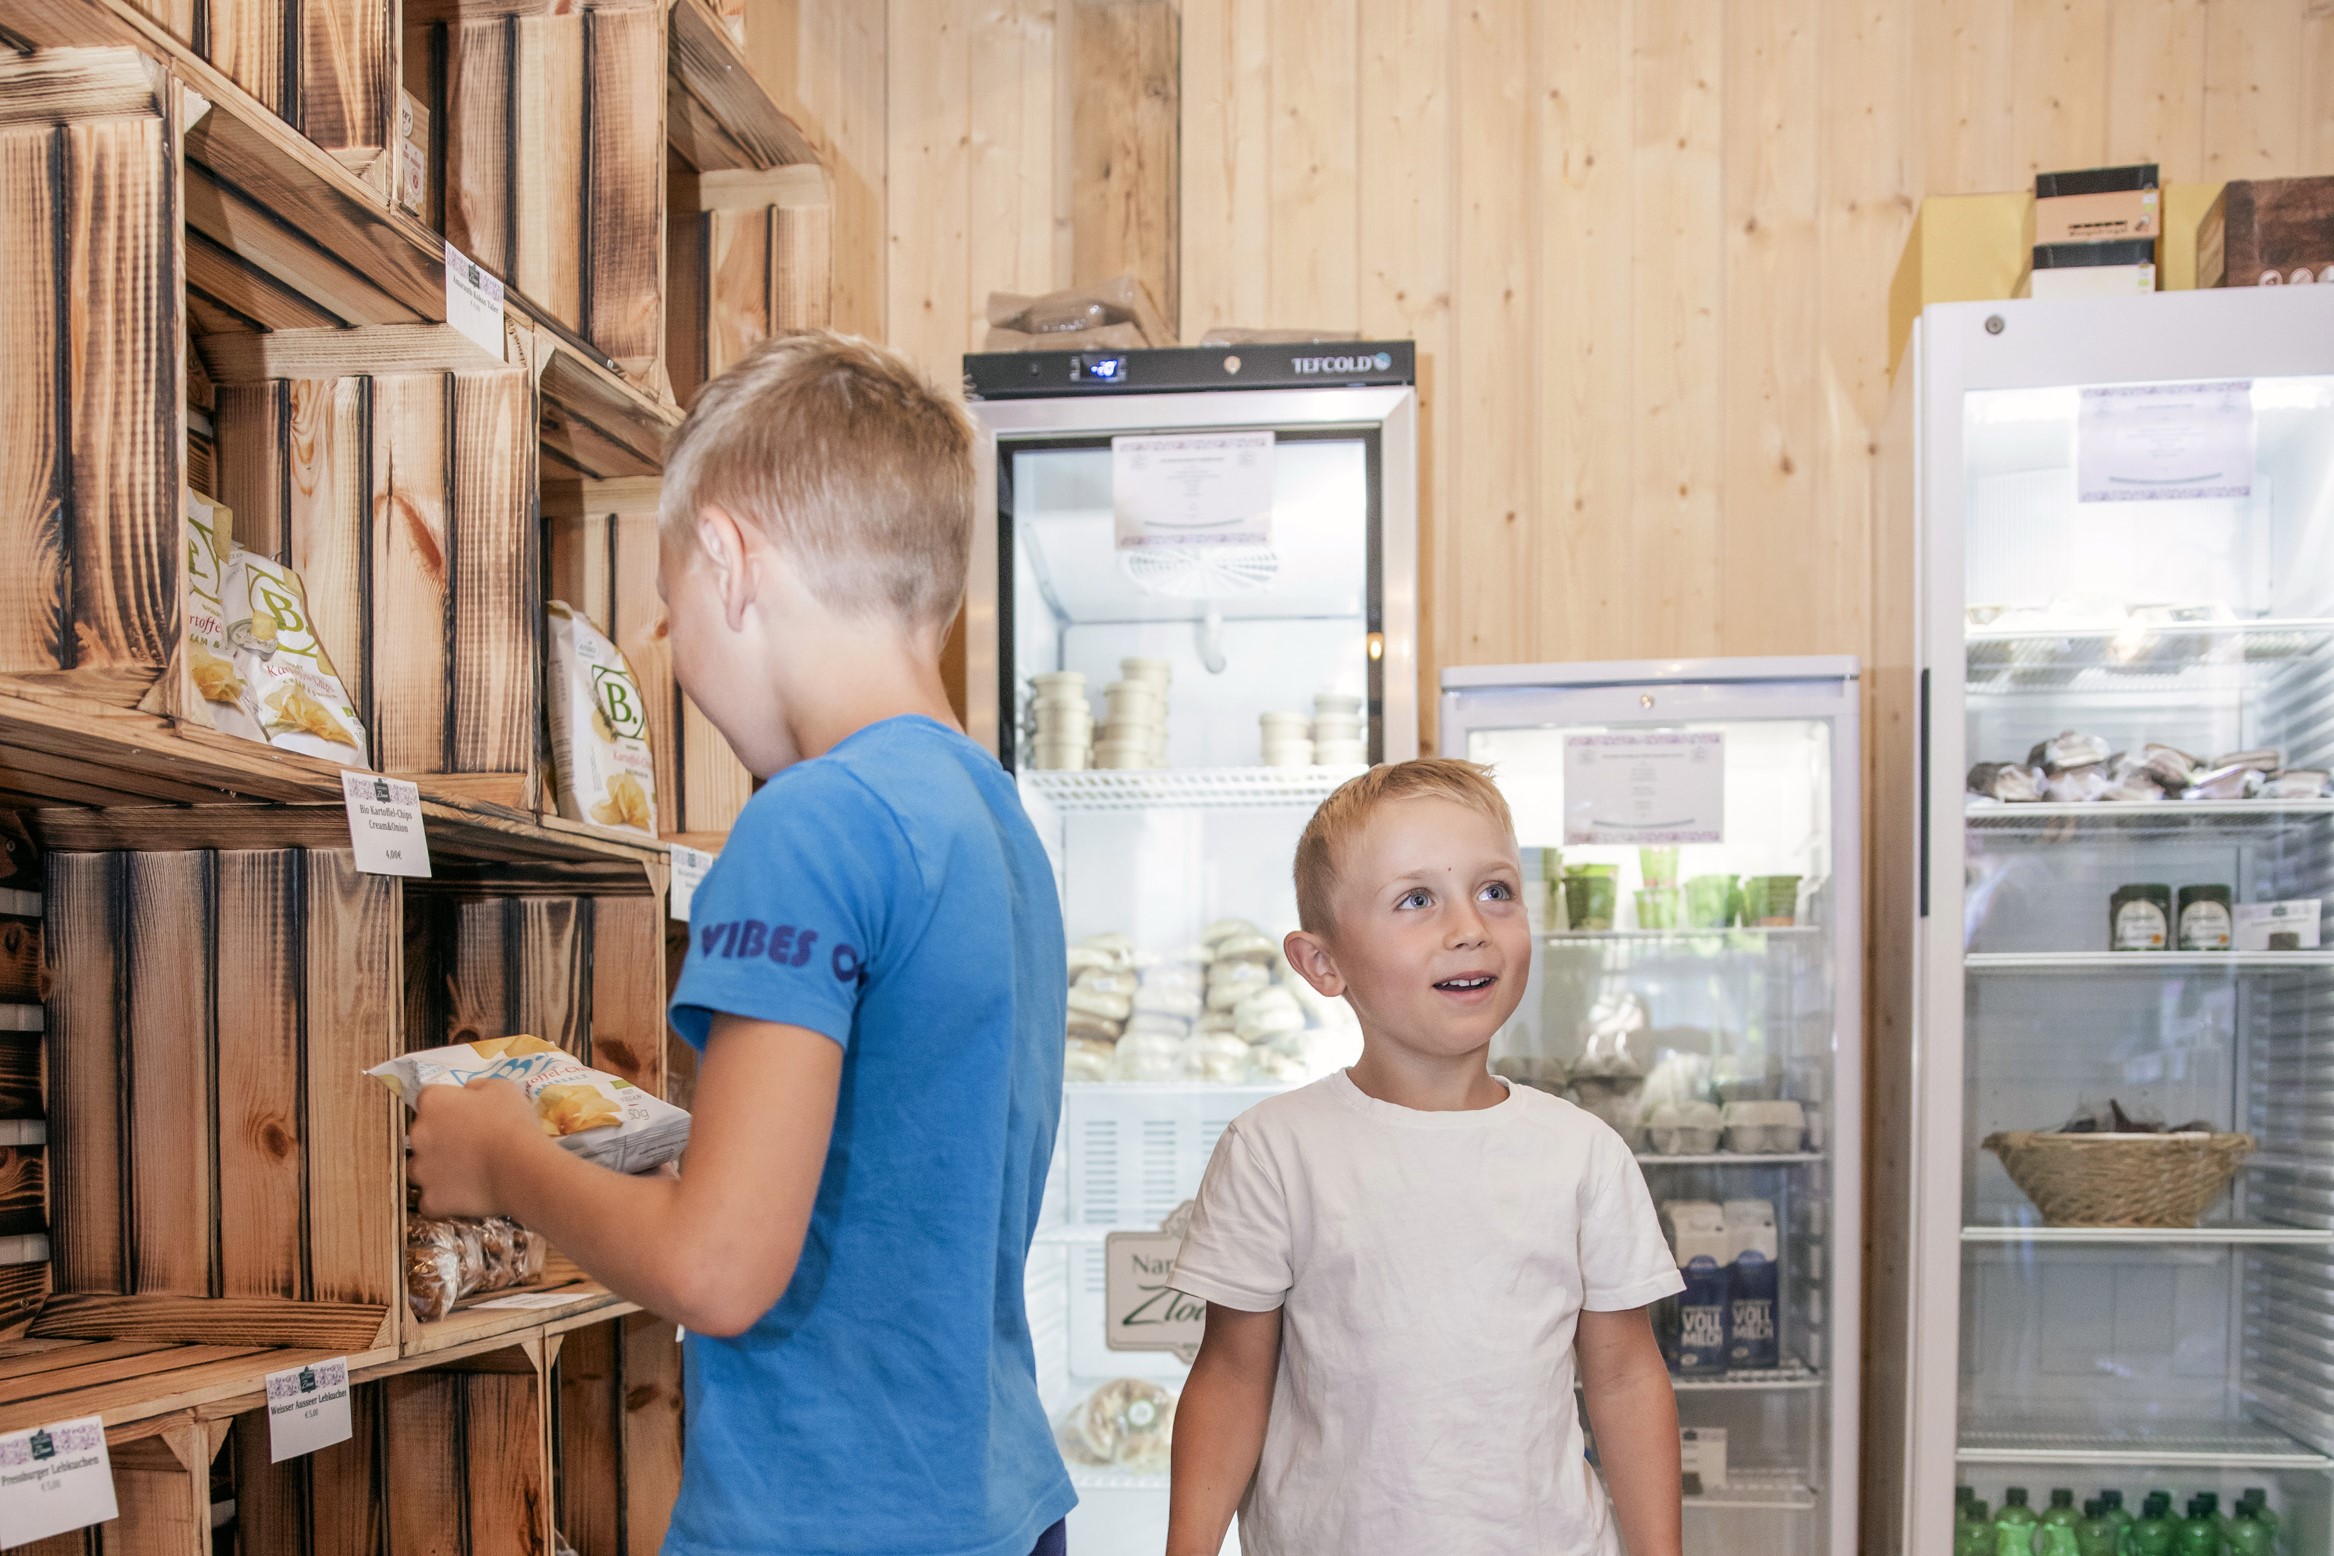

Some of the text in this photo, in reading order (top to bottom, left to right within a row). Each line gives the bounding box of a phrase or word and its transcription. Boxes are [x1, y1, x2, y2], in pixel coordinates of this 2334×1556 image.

[1291, 355, 1373, 374] TEFCOLD
[189, 613, 222, 634] rtoffe
[190, 633, 209, 646] EAM
[360, 804, 413, 821] Bio Kartoffel-Chips
[368, 819, 409, 833] Cream&Onion
[385, 849, 403, 860] 4,00€
[702, 919, 819, 968] VIBES
[628, 1107, 649, 1121] 50g
[1682, 1311, 1721, 1332] VOLL
[1732, 1305, 1770, 1325] VOLL
[1682, 1329, 1724, 1347] MILCH
[270, 1403, 294, 1415] Weisser
[295, 1396, 318, 1409] Ausseer
[50, 1455, 100, 1475] Lebkuchen
